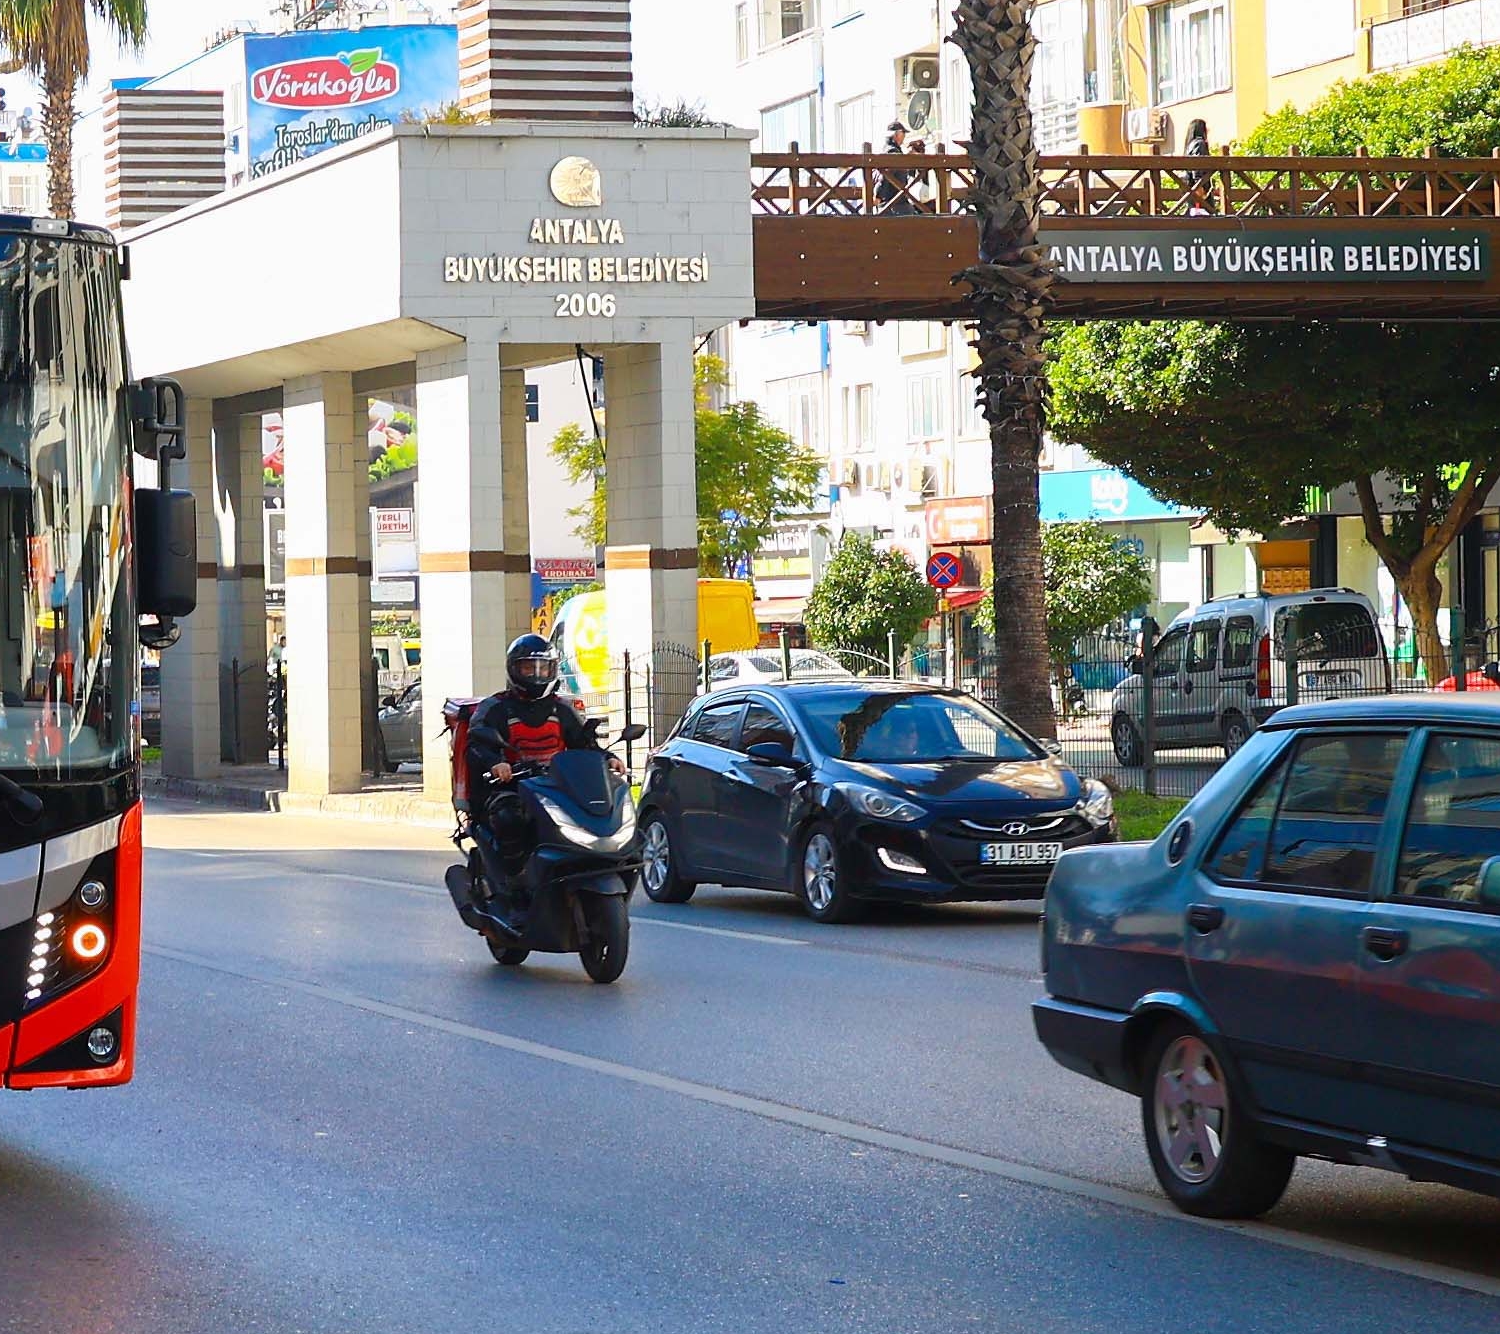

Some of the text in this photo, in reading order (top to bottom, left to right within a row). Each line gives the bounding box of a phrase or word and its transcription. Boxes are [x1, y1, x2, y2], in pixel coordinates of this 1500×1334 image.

[529, 218, 624, 244] ANTALYA
[587, 252, 709, 282] BELEDİYESİ
[1049, 238, 1481, 278] ANTALYA BÜYÜKŞEHİR BELEDİYESİ
[555, 292, 617, 318] 2006
[988, 843, 1059, 860] 31 AEU 957
